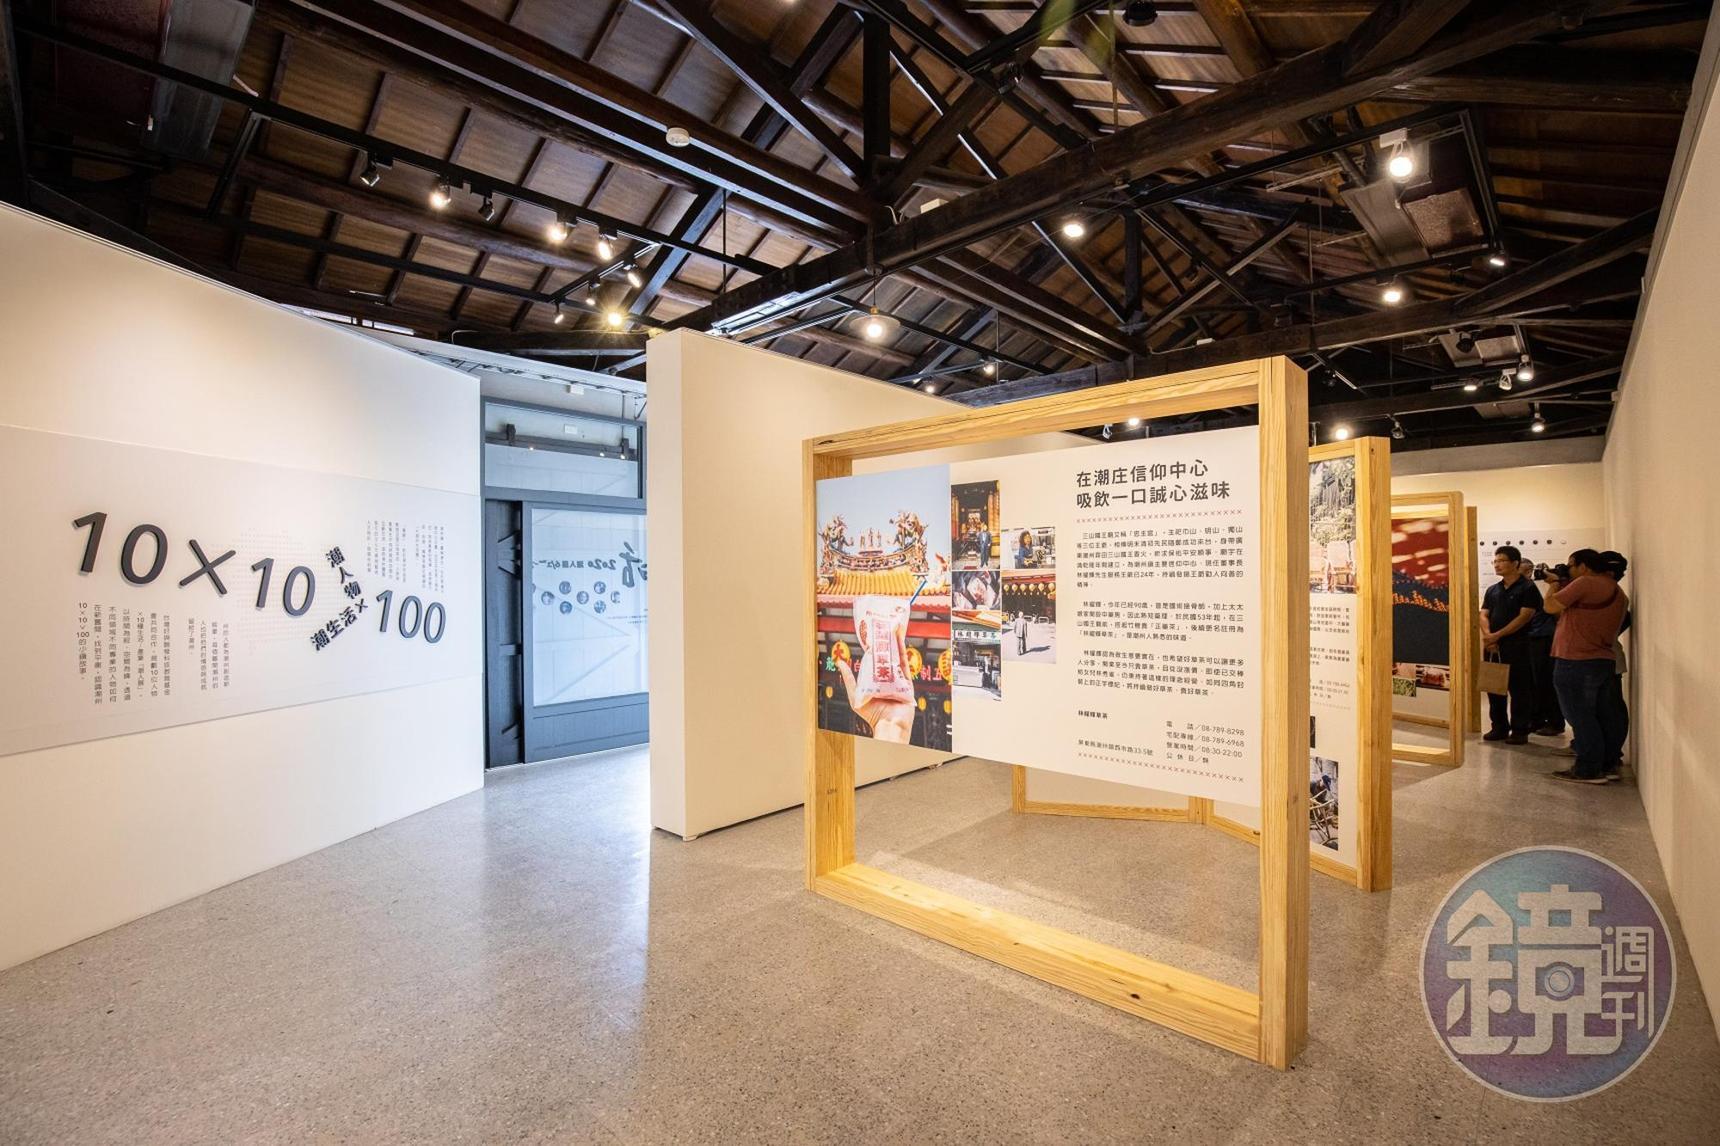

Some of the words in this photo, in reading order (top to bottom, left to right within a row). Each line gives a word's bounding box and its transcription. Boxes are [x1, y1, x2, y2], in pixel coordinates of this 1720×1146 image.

[1076, 459, 1208, 488] 在潮庄信仰中心
[1076, 481, 1230, 509] 吸飲一口誠心滋味
[309, 606, 358, 652] 潮生活
[374, 589, 448, 644] 100
